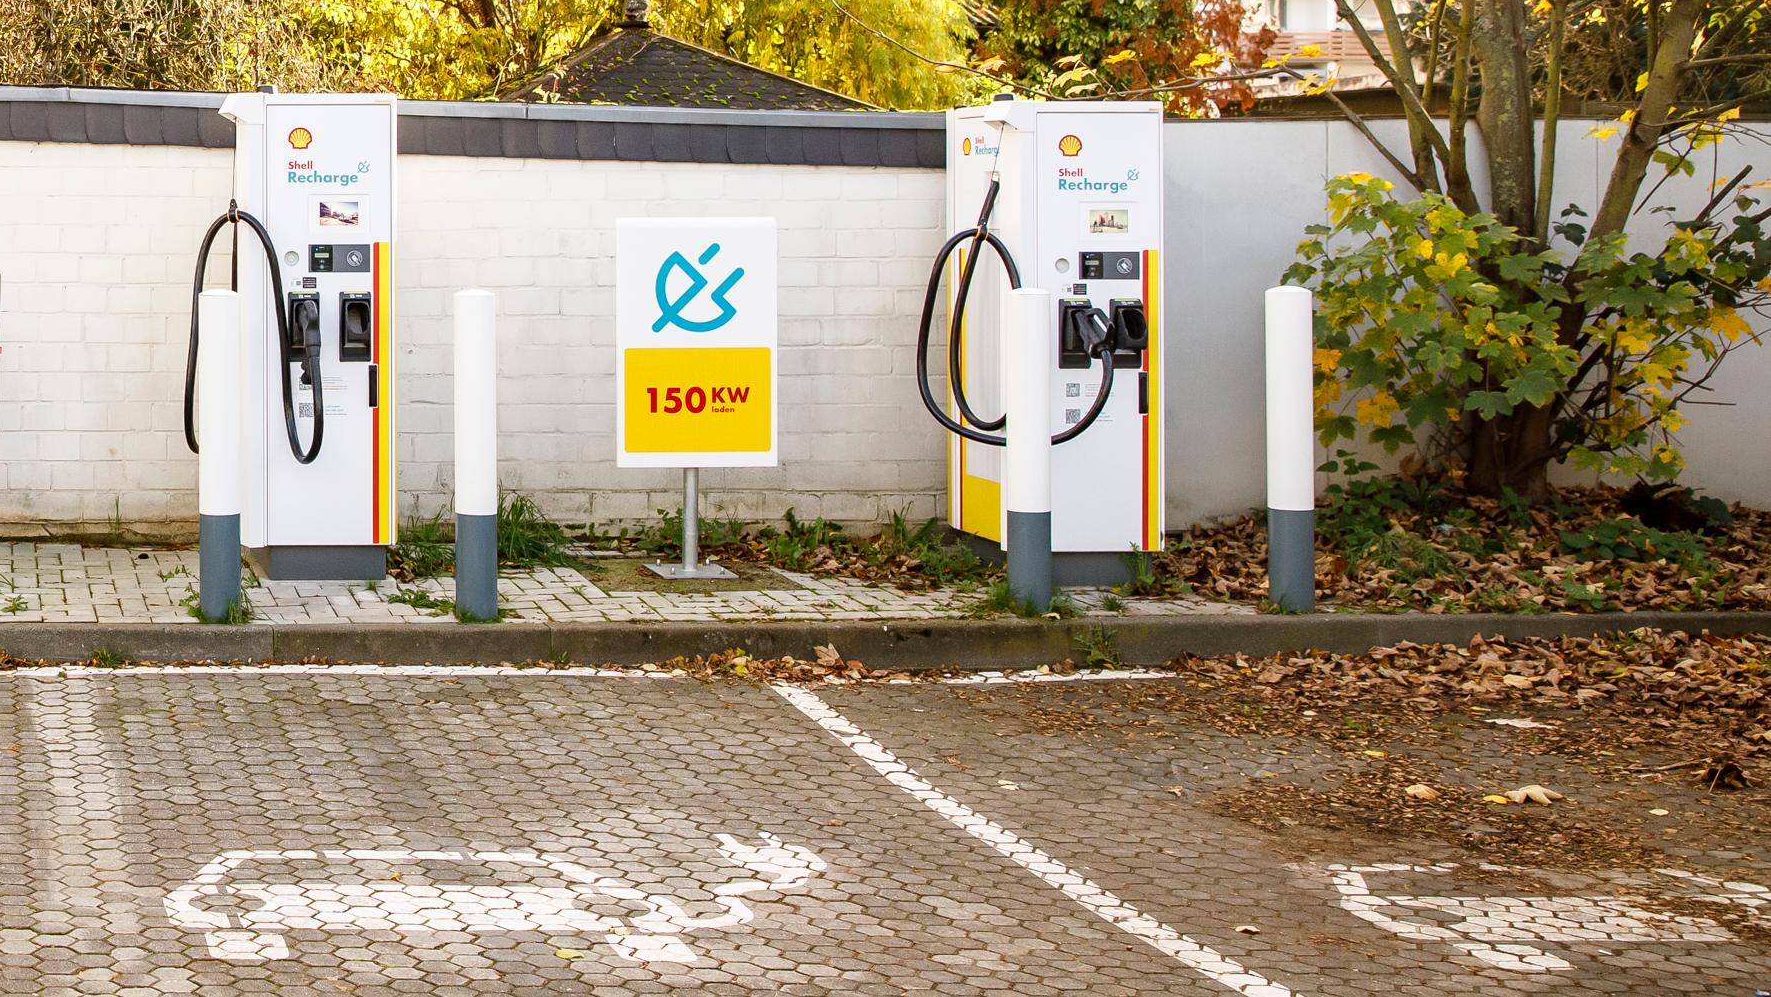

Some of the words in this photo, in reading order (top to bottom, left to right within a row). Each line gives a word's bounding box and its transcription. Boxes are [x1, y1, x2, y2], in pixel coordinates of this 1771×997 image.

[288, 160, 313, 170] Shell
[288, 170, 359, 186] Recharge
[1058, 168, 1083, 177] Shell
[1058, 178, 1128, 194] Recharge
[647, 387, 707, 414] 150
[712, 386, 750, 403] KW
[712, 405, 735, 413] laden
